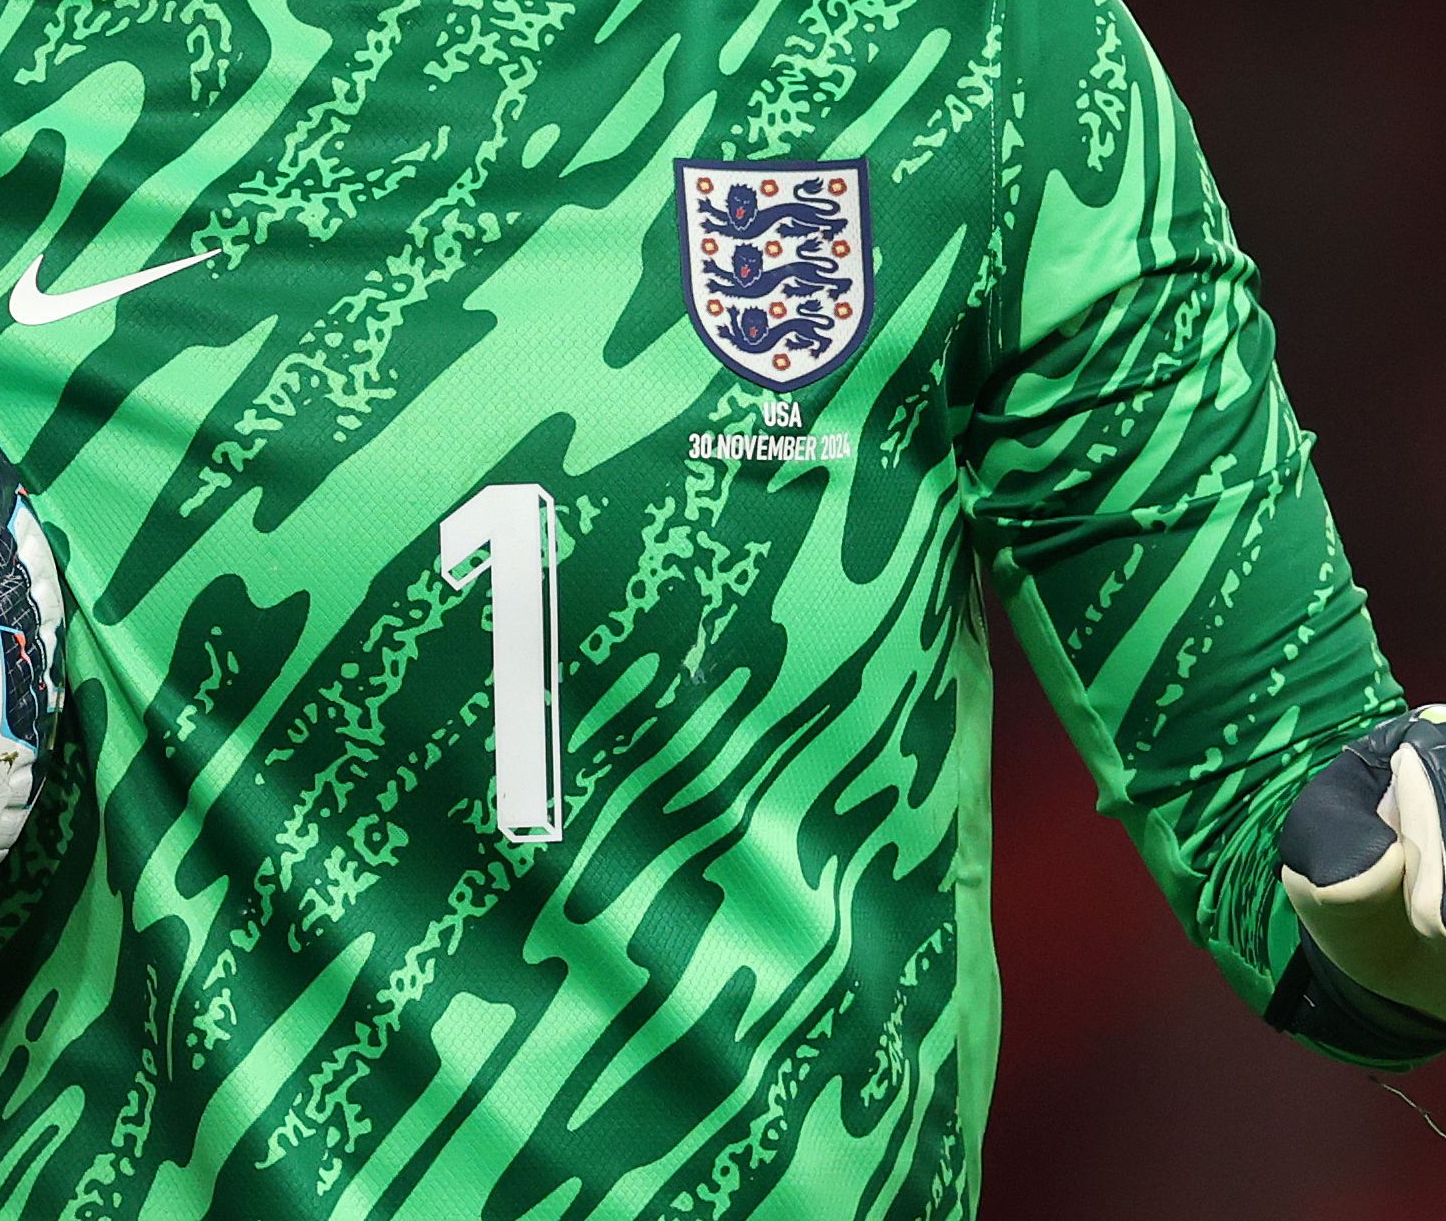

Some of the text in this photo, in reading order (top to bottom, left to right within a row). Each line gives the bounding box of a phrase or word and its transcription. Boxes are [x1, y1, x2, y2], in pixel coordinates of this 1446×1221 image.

[762, 401, 803, 428] USA
[688, 431, 852, 461] 30 NOVEMBER 2024
[439, 483, 563, 843] 1
